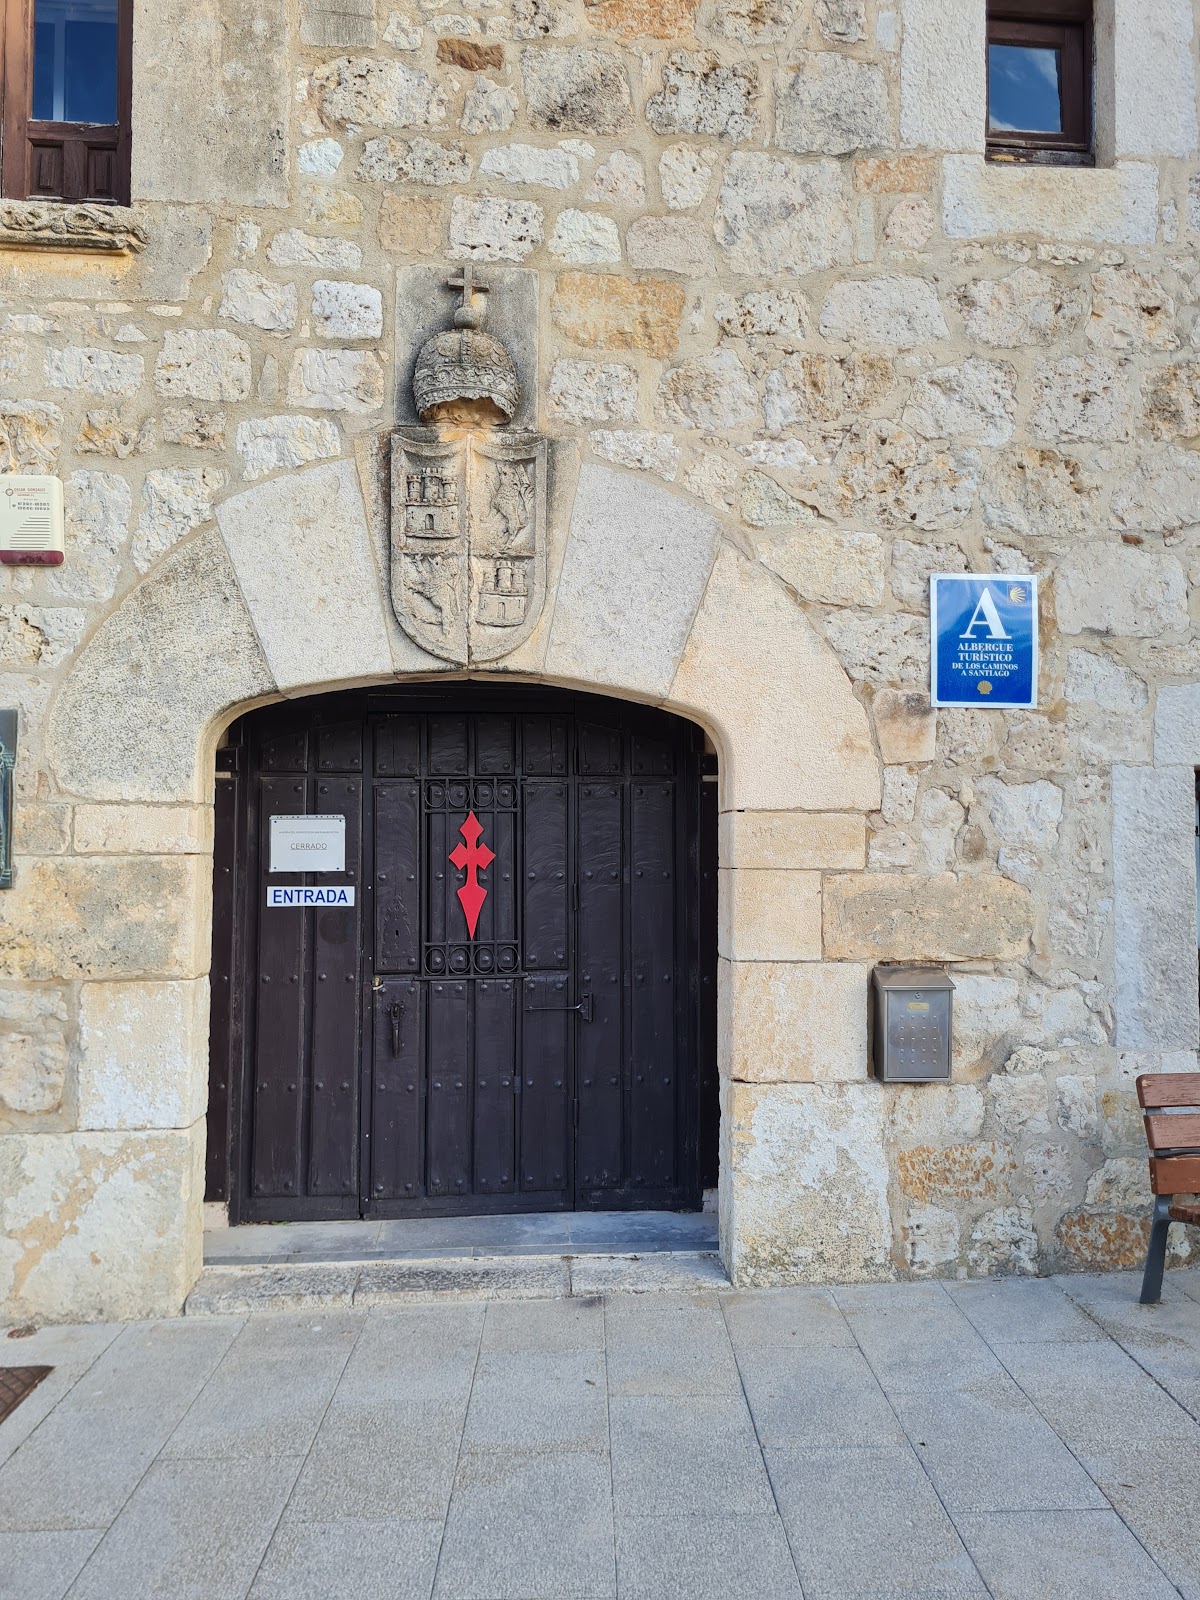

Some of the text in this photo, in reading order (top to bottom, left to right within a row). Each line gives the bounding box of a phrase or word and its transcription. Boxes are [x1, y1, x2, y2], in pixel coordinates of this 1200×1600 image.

[959, 587, 1012, 639] A
[957, 642, 1013, 652] ALBERGUE
[958, 650, 1012, 662] TURÍSTICO
[290, 842, 328, 850] CERRADO
[273, 889, 348, 904] ENTRADA
